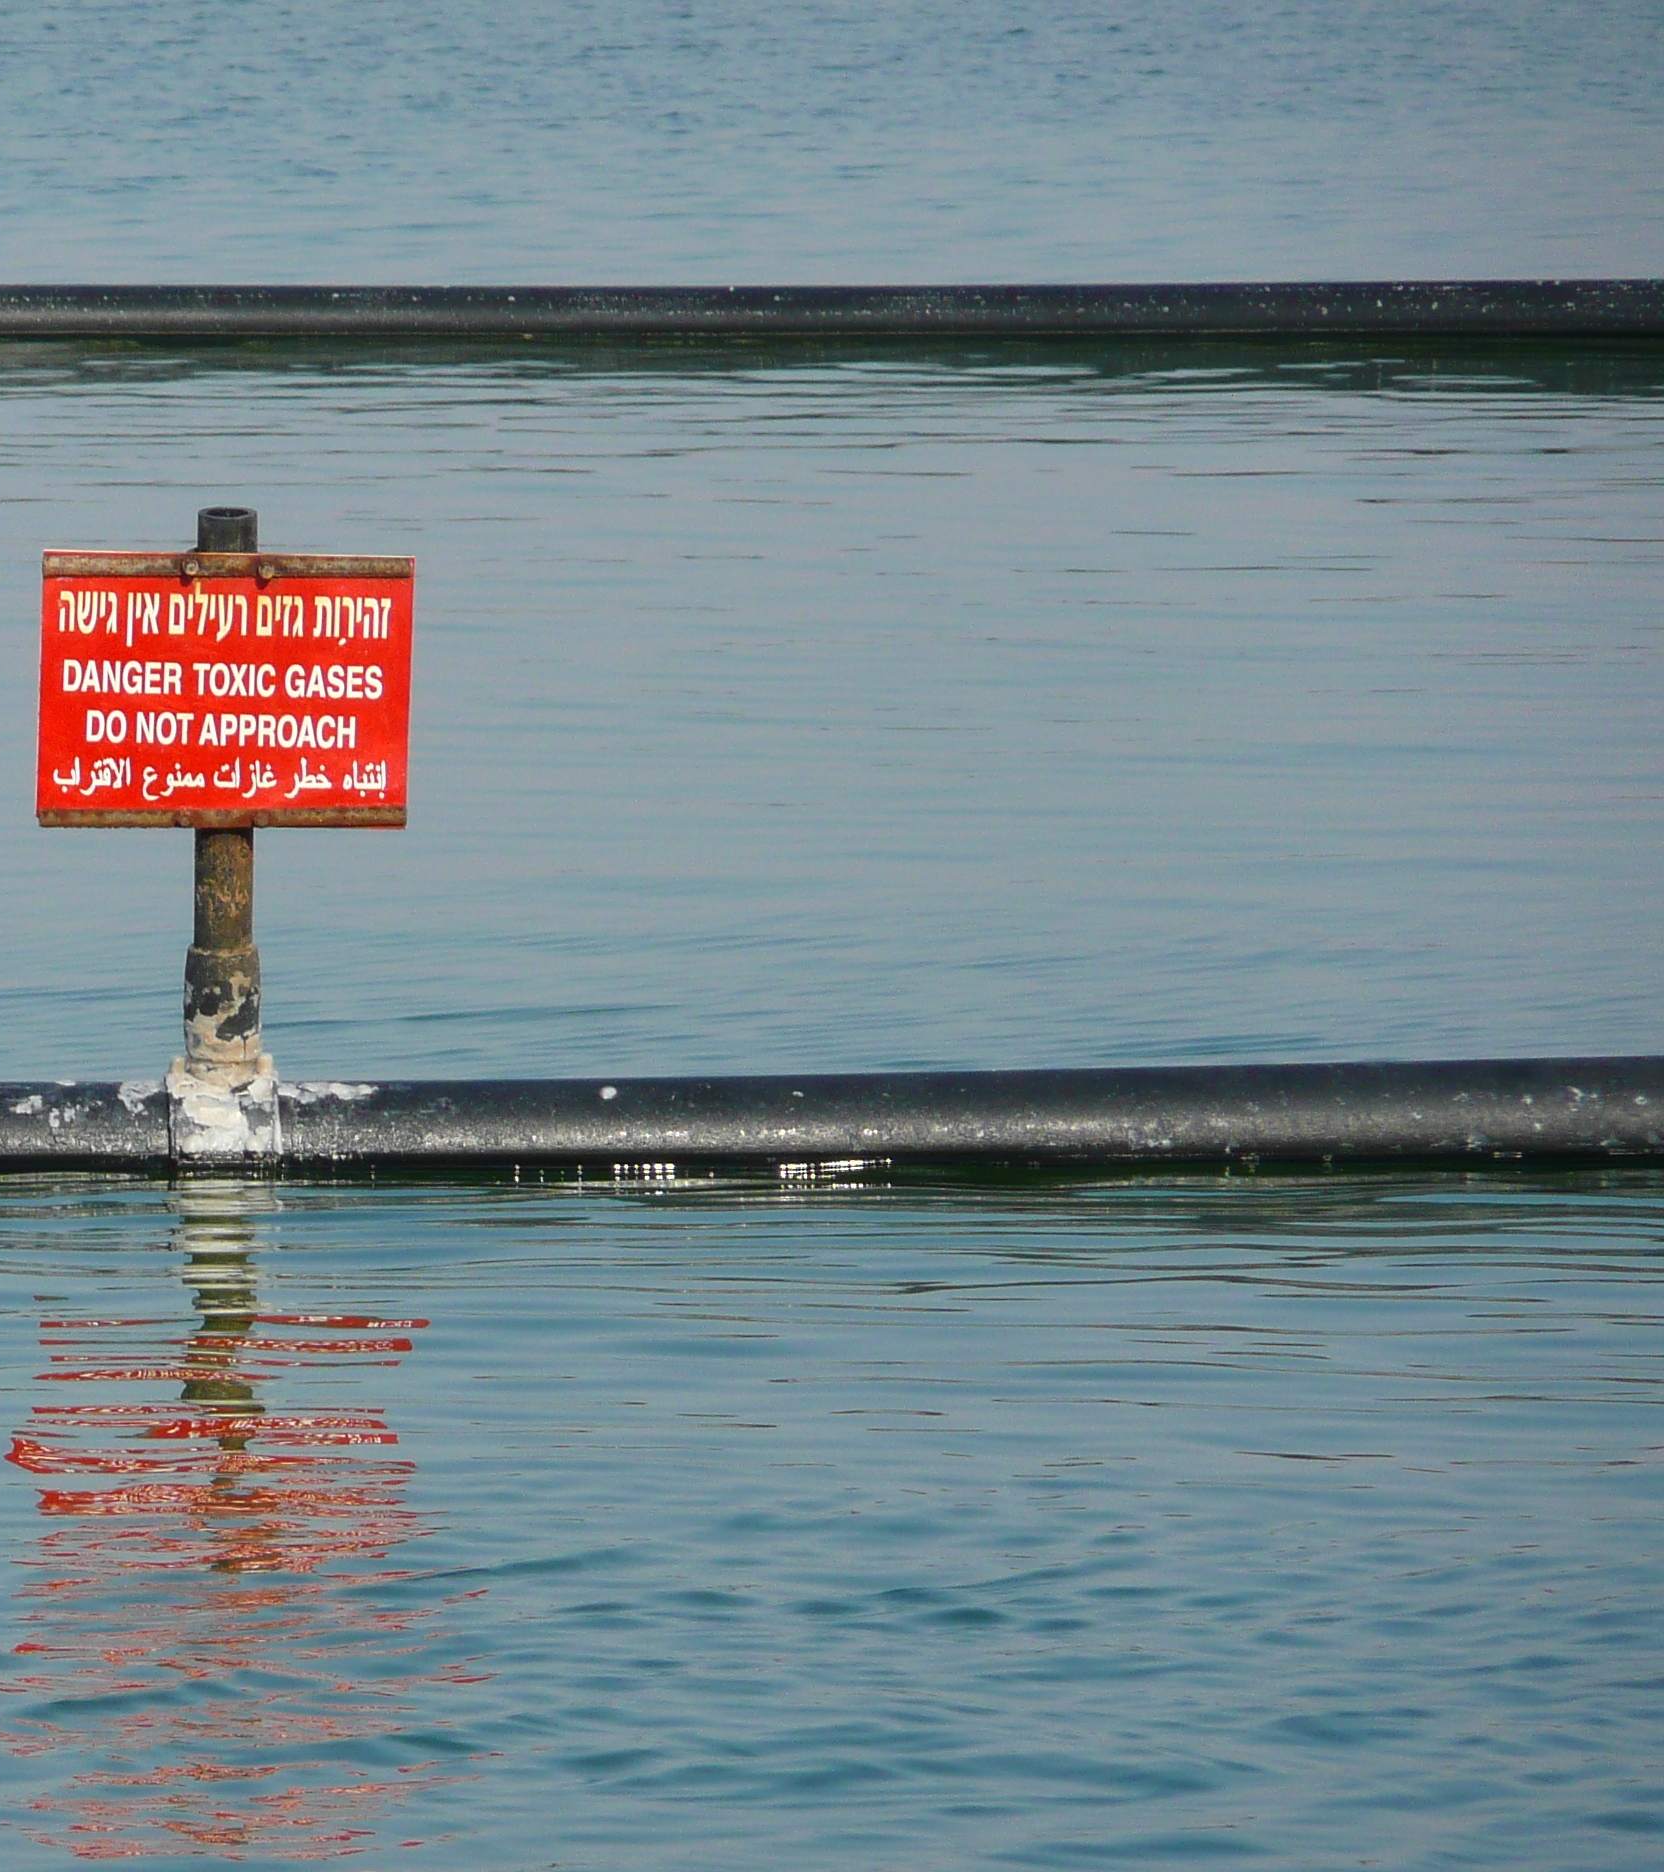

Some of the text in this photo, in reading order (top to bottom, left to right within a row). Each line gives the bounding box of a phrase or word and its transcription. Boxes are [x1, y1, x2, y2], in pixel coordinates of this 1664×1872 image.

[58, 582, 392, 647] זהירות גזים רעילים אין גישה
[62, 659, 383, 700] DANGER TOXIC GASES
[85, 709, 357, 750] DO NOT APPROACH
[52, 756, 132, 796] الاقتراب
[142, 762, 206, 802] ممنوع
[213, 756, 278, 799] غازات
[283, 756, 333, 799] خطر
